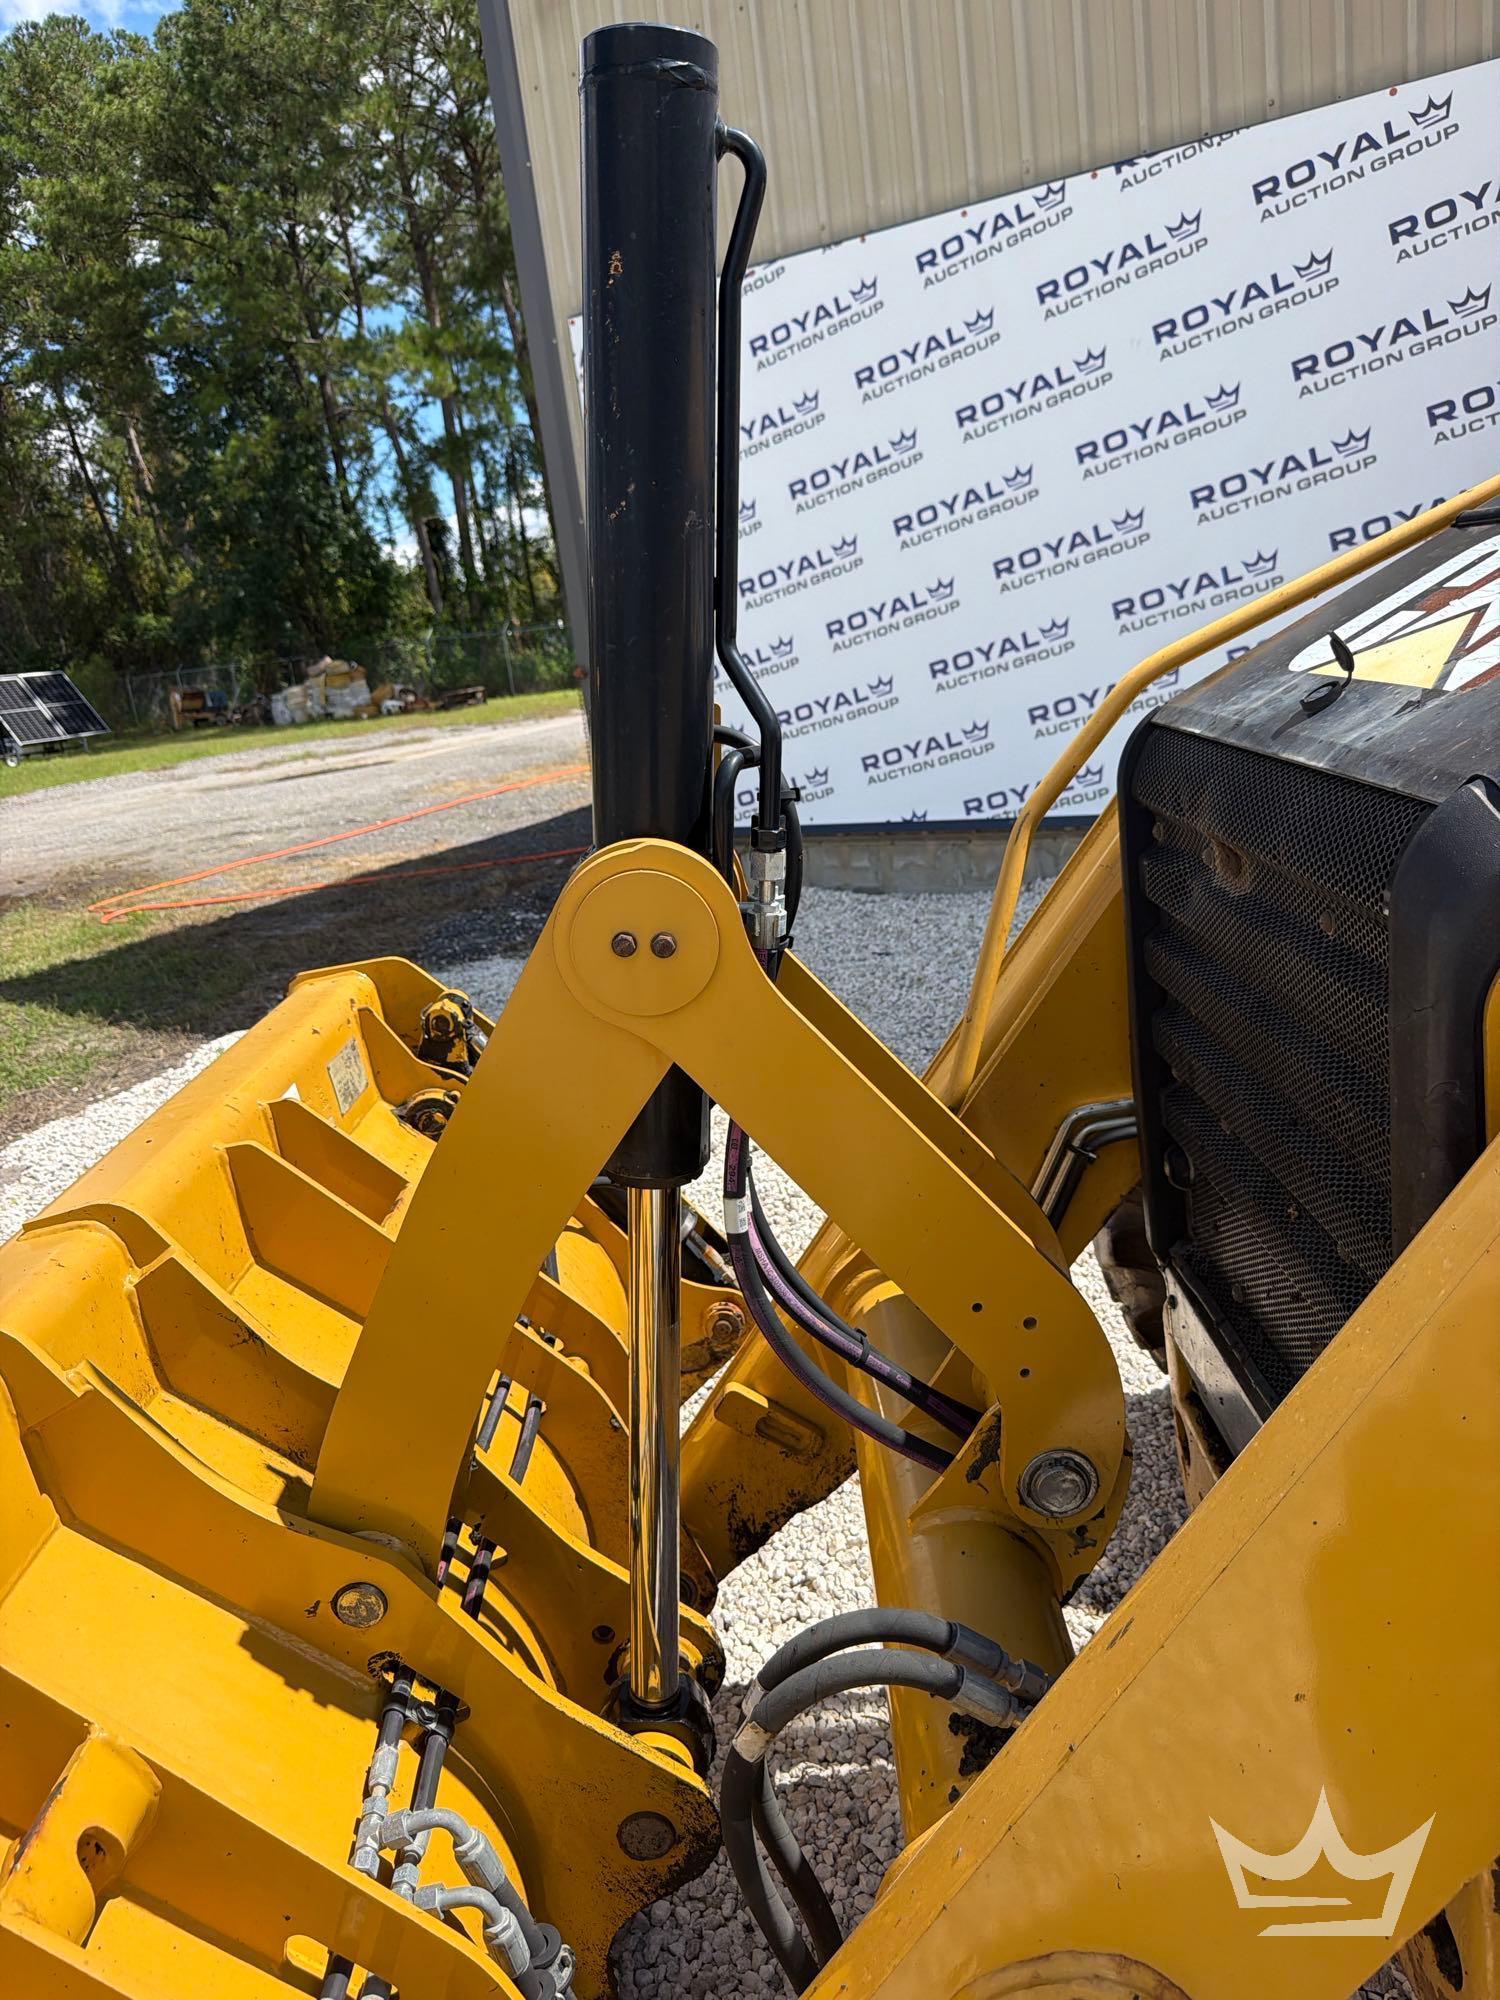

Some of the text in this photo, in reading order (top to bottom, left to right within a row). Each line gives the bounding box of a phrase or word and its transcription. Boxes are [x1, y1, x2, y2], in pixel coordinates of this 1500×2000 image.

[1120, 137, 1214, 192] AUCTION
[1252, 120, 1410, 206] ROYAL
[1260, 123, 1459, 223] AUCTION GROUP
[916, 203, 1036, 274] ROYAL
[1388, 180, 1500, 246] ROY
[924, 206, 1073, 289] AUCTION GROUP
[1036, 234, 1167, 306] ROYAL
[742, 266, 786, 297] ROUP
[1044, 237, 1208, 321] AUCTION GROUP
[749, 296, 852, 358] ROYAL
[757, 300, 884, 371] AUCTION GROUP
[1152, 273, 1295, 345] ROYAL
[1160, 278, 1339, 361] AUCTION GROUP
[854, 328, 966, 390] ROYAL
[862, 332, 1000, 404] AUCTION GROUP
[1291, 308, 1449, 382] ROYAL
[1299, 314, 1497, 398] AUCTION GROUP
[740, 407, 796, 441] YAL
[955, 366, 1076, 428] ROYAL
[963, 372, 1112, 443] AUCTION GROUP
[772, 413, 825, 445] GROUP
[1075, 402, 1206, 465] ROYAL
[1083, 409, 1246, 480] AUCTION GROUP
[1434, 412, 1500, 445] AUCT
[788, 446, 891, 500] ROYAL
[796, 452, 923, 514] AUCTION GROUP
[1190, 447, 1333, 510] ROYAL
[1198, 455, 1376, 525] AUCTION GROUP
[892, 482, 1004, 537] ROYAL
[900, 489, 1039, 550] AUCTION GROUP
[1329, 497, 1446, 552] ROY
[739, 550, 834, 597] ROYAL
[993, 524, 1113, 579] ROYAL
[1000, 533, 1150, 593] AUCTION GROUP
[746, 558, 863, 610] AUCTION GROUP
[1112, 566, 1243, 620] ROYAL
[1120, 576, 1284, 635] AUCTION GROUP
[826, 592, 928, 640] ROYAL
[834, 600, 960, 652] AUCTION GROUP
[929, 632, 1040, 679] ROYAL
[936, 641, 1075, 692] AUCTION GROUP
[777, 688, 870, 727] ROYAL
[846, 697, 899, 720] GROUP
[1028, 684, 1116, 725] ROY
[1034, 714, 1094, 739] AUCTI
[861, 732, 963, 772] ROYAL
[868, 742, 995, 784] AUCTION GROUP
[800, 787, 834, 803] OUP
[963, 780, 1042, 816] ROY
[1052, 787, 1109, 809] ROUP
